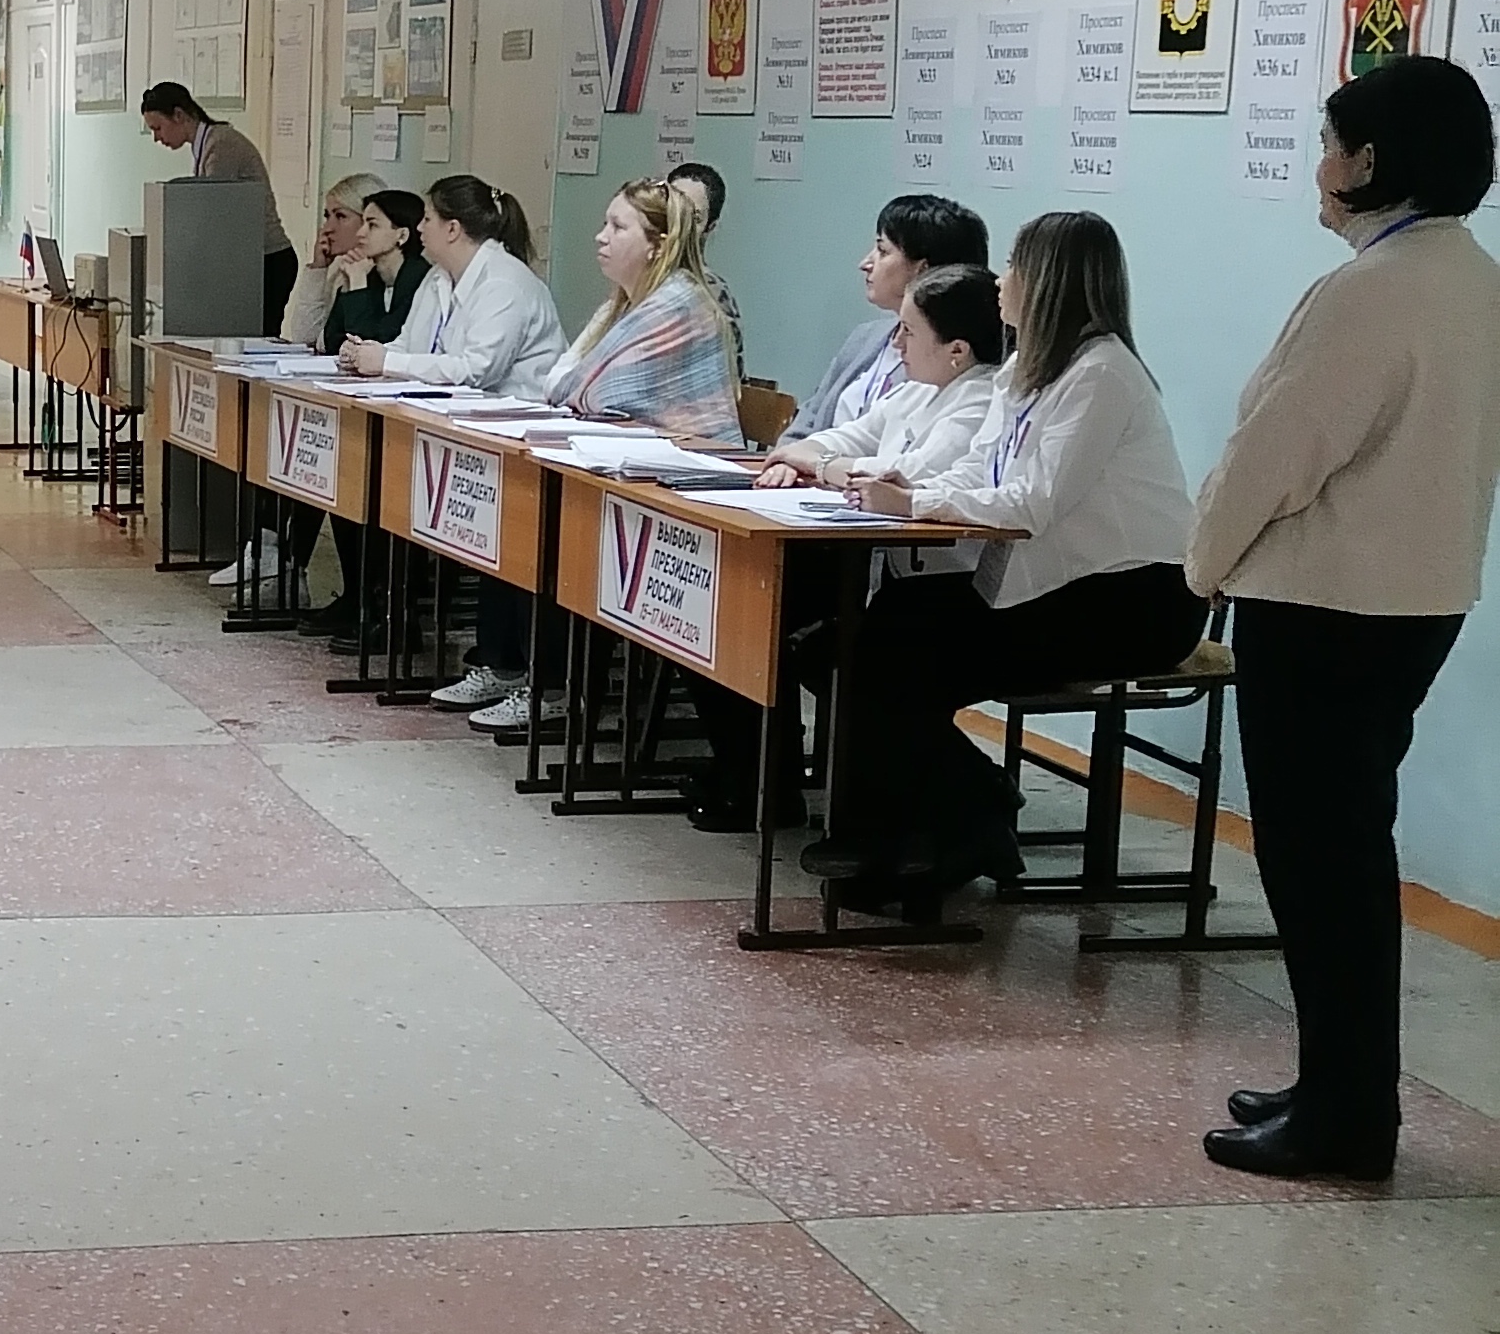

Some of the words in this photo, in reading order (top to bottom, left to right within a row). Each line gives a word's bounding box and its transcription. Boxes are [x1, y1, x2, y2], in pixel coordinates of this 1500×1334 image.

[1257, 0, 1307, 22] Проспект
[989, 20, 1029, 37] Проспект
[1079, 13, 1123, 33] Проспект
[912, 26, 947, 43] Проспект
[1253, 28, 1306, 47] Химиков
[986, 44, 1029, 59] Химиков
[1076, 39, 1124, 56] Химиков
[994, 69, 1016, 85] №26
[1077, 66, 1101, 83] №34
[1253, 58, 1279, 77] №36
[908, 106, 942, 124] Проспект
[984, 106, 1023, 124] Проспект
[1073, 105, 1117, 125] Проспект
[1249, 103, 1296, 124] Проспект
[904, 129, 943, 145] Химиков
[981, 130, 1023, 146] Химиков
[1070, 131, 1117, 148] Химиков
[1244, 131, 1295, 150] Химиков
[1070, 158, 1094, 175] №34
[1244, 161, 1270, 180] №36
[454, 451, 488, 476] ВЫБОРЫ
[451, 474, 496, 506] ПРЕЗИДЕНТА
[446, 497, 476, 523] РОССИИ
[656, 520, 702, 556] ВЫБОРЫ
[650, 549, 712, 592] ПРЕЗИДЕНТА
[645, 576, 685, 610] РОССИИ
[659, 613, 682, 637] МАРТА
[681, 622, 701, 645] 2024
